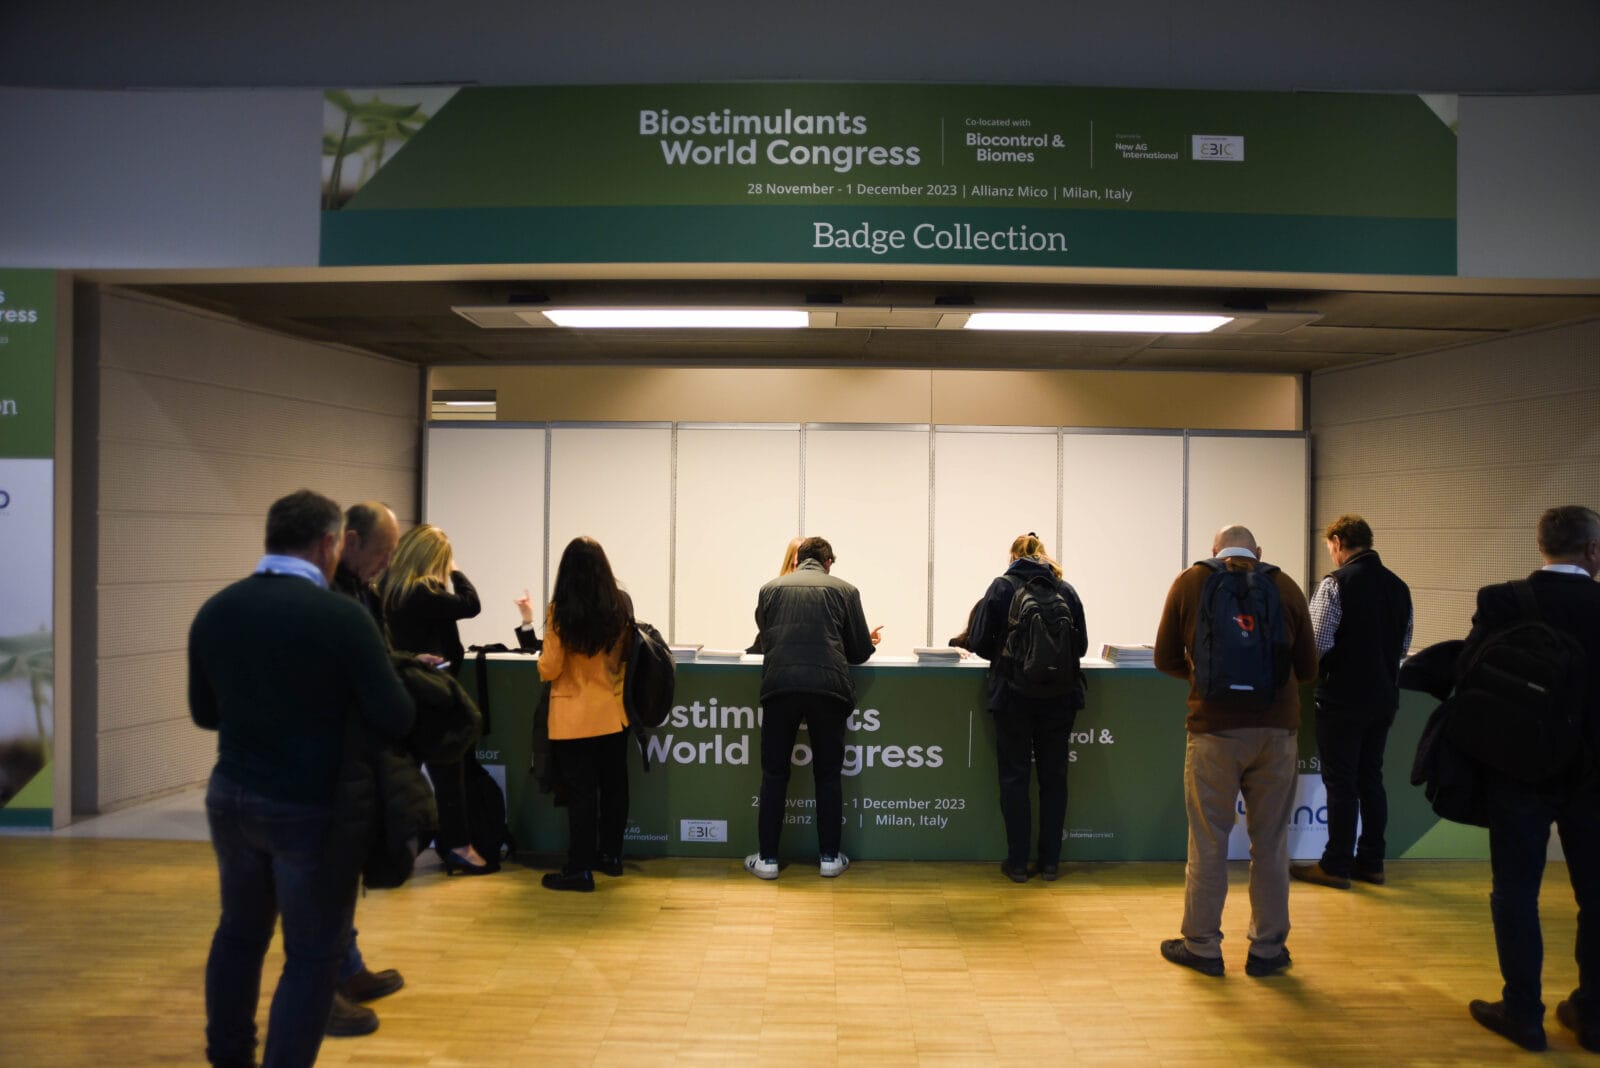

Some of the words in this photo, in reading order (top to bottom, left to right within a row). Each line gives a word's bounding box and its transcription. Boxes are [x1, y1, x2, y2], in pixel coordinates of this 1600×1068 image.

[639, 108, 867, 135] Biostimulants
[965, 118, 1011, 128] Co-located
[1012, 118, 1031, 128] with
[966, 133, 1048, 148] Biocontrol
[1051, 134, 1065, 148] &
[1115, 143, 1134, 151] New
[1135, 143, 1148, 151] AG
[660, 138, 758, 166] World
[766, 139, 921, 173] Congress
[976, 148, 1035, 163] Biomes
[1122, 151, 1179, 161] International
[747, 183, 763, 195] 28
[766, 183, 834, 195] November
[846, 183, 852, 195] 1
[857, 183, 923, 196] December
[926, 184, 958, 197] 2023
[971, 184, 1015, 198] Allianz
[1018, 185, 1049, 199] Mico
[1062, 187, 1101, 200] Milan,
[1105, 187, 1133, 203] Italy
[812, 221, 907, 255] Badge
[913, 223, 1069, 253] Collection
[1098, 728, 1114, 744] &
[852, 798, 858, 809] 1
[862, 798, 932, 810] December
[934, 798, 966, 811] 2023
[875, 814, 916, 827] Milan,
[919, 814, 949, 829] Italy
